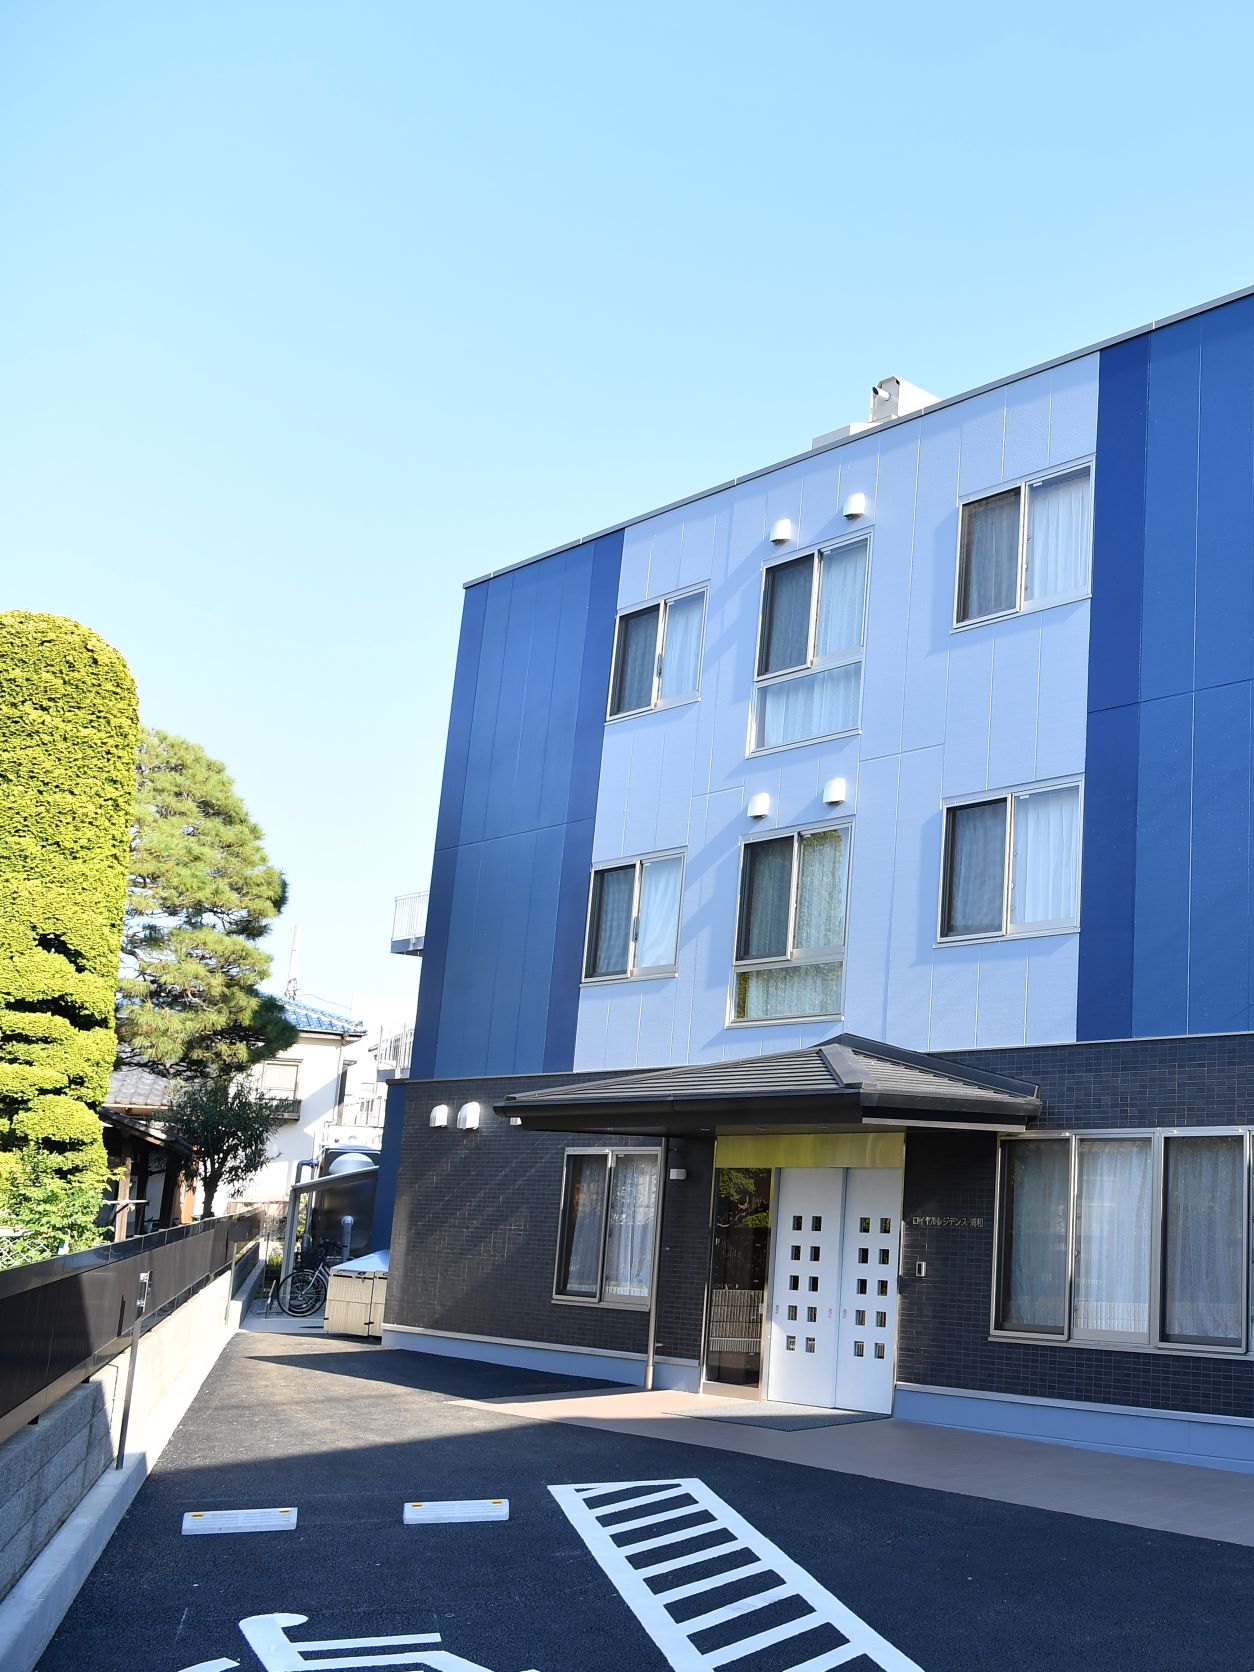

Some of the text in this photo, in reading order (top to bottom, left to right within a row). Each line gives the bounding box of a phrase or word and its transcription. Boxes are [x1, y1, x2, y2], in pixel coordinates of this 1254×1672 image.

[912, 1216, 984, 1228] ロイヤルレジデンス 浦和
